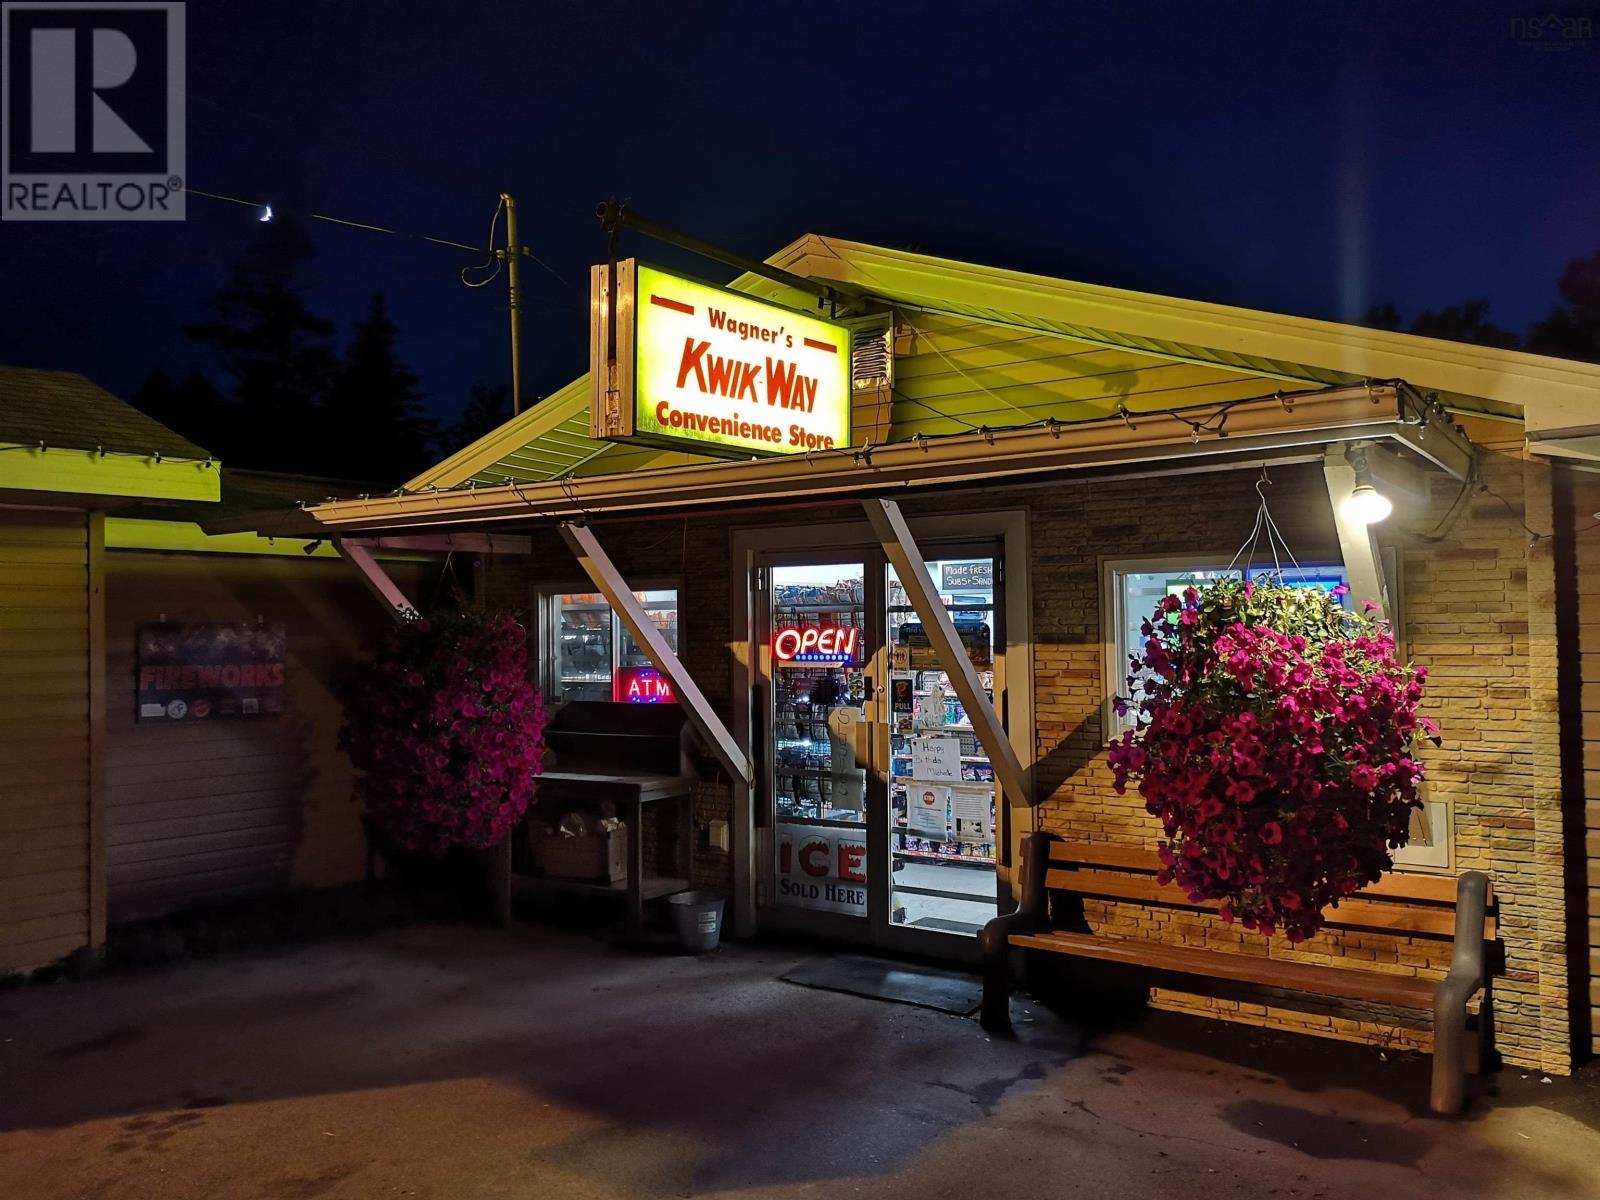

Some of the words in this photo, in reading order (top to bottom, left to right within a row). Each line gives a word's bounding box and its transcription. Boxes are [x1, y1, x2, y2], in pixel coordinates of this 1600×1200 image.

[708, 307, 793, 348] Wagner's
[656, 401, 782, 443] Convenience
[789, 424, 834, 450] Store
[775, 627, 857, 660] OPEN
[139, 663, 286, 690] FIREWORKS
[629, 680, 670, 695] ATM
[894, 702, 912, 710] PULL
[780, 833, 866, 883] ICE
[780, 878, 819, 899] SOLD
[825, 883, 865, 906] HERE
